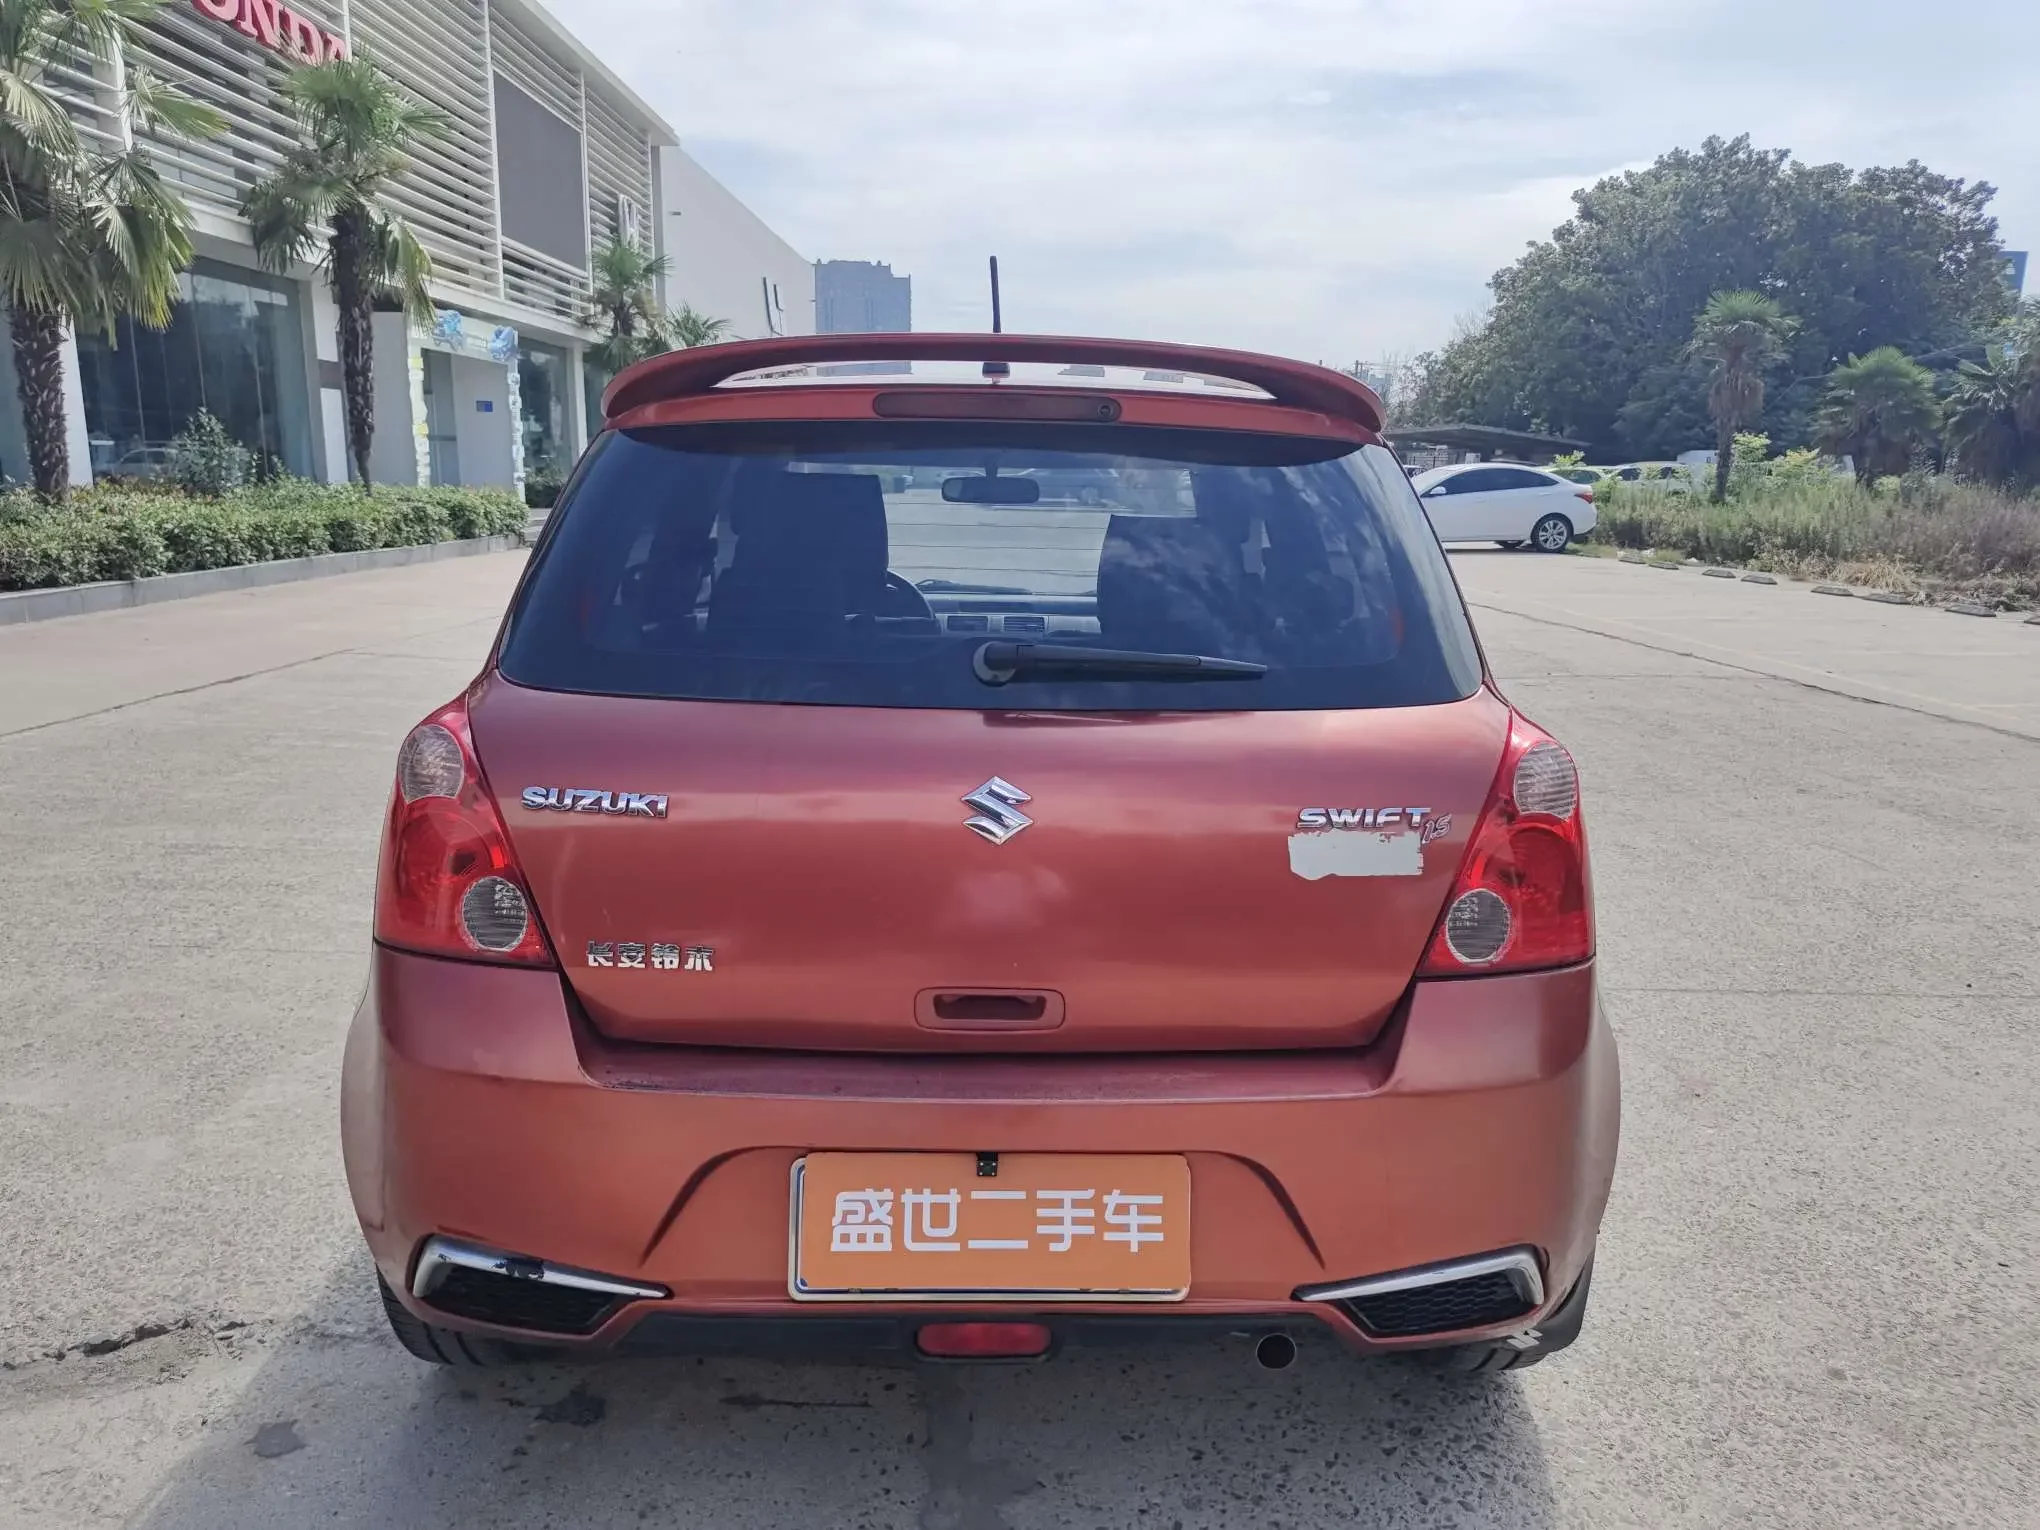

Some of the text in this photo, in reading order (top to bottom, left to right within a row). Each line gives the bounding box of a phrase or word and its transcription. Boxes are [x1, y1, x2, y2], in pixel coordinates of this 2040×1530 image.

[521, 786, 669, 818] SUZUKI
[1297, 807, 1431, 828] SWIFT
[586, 940, 713, 971] 长安铃木
[830, 1188, 1164, 1253] 盛世二手车
